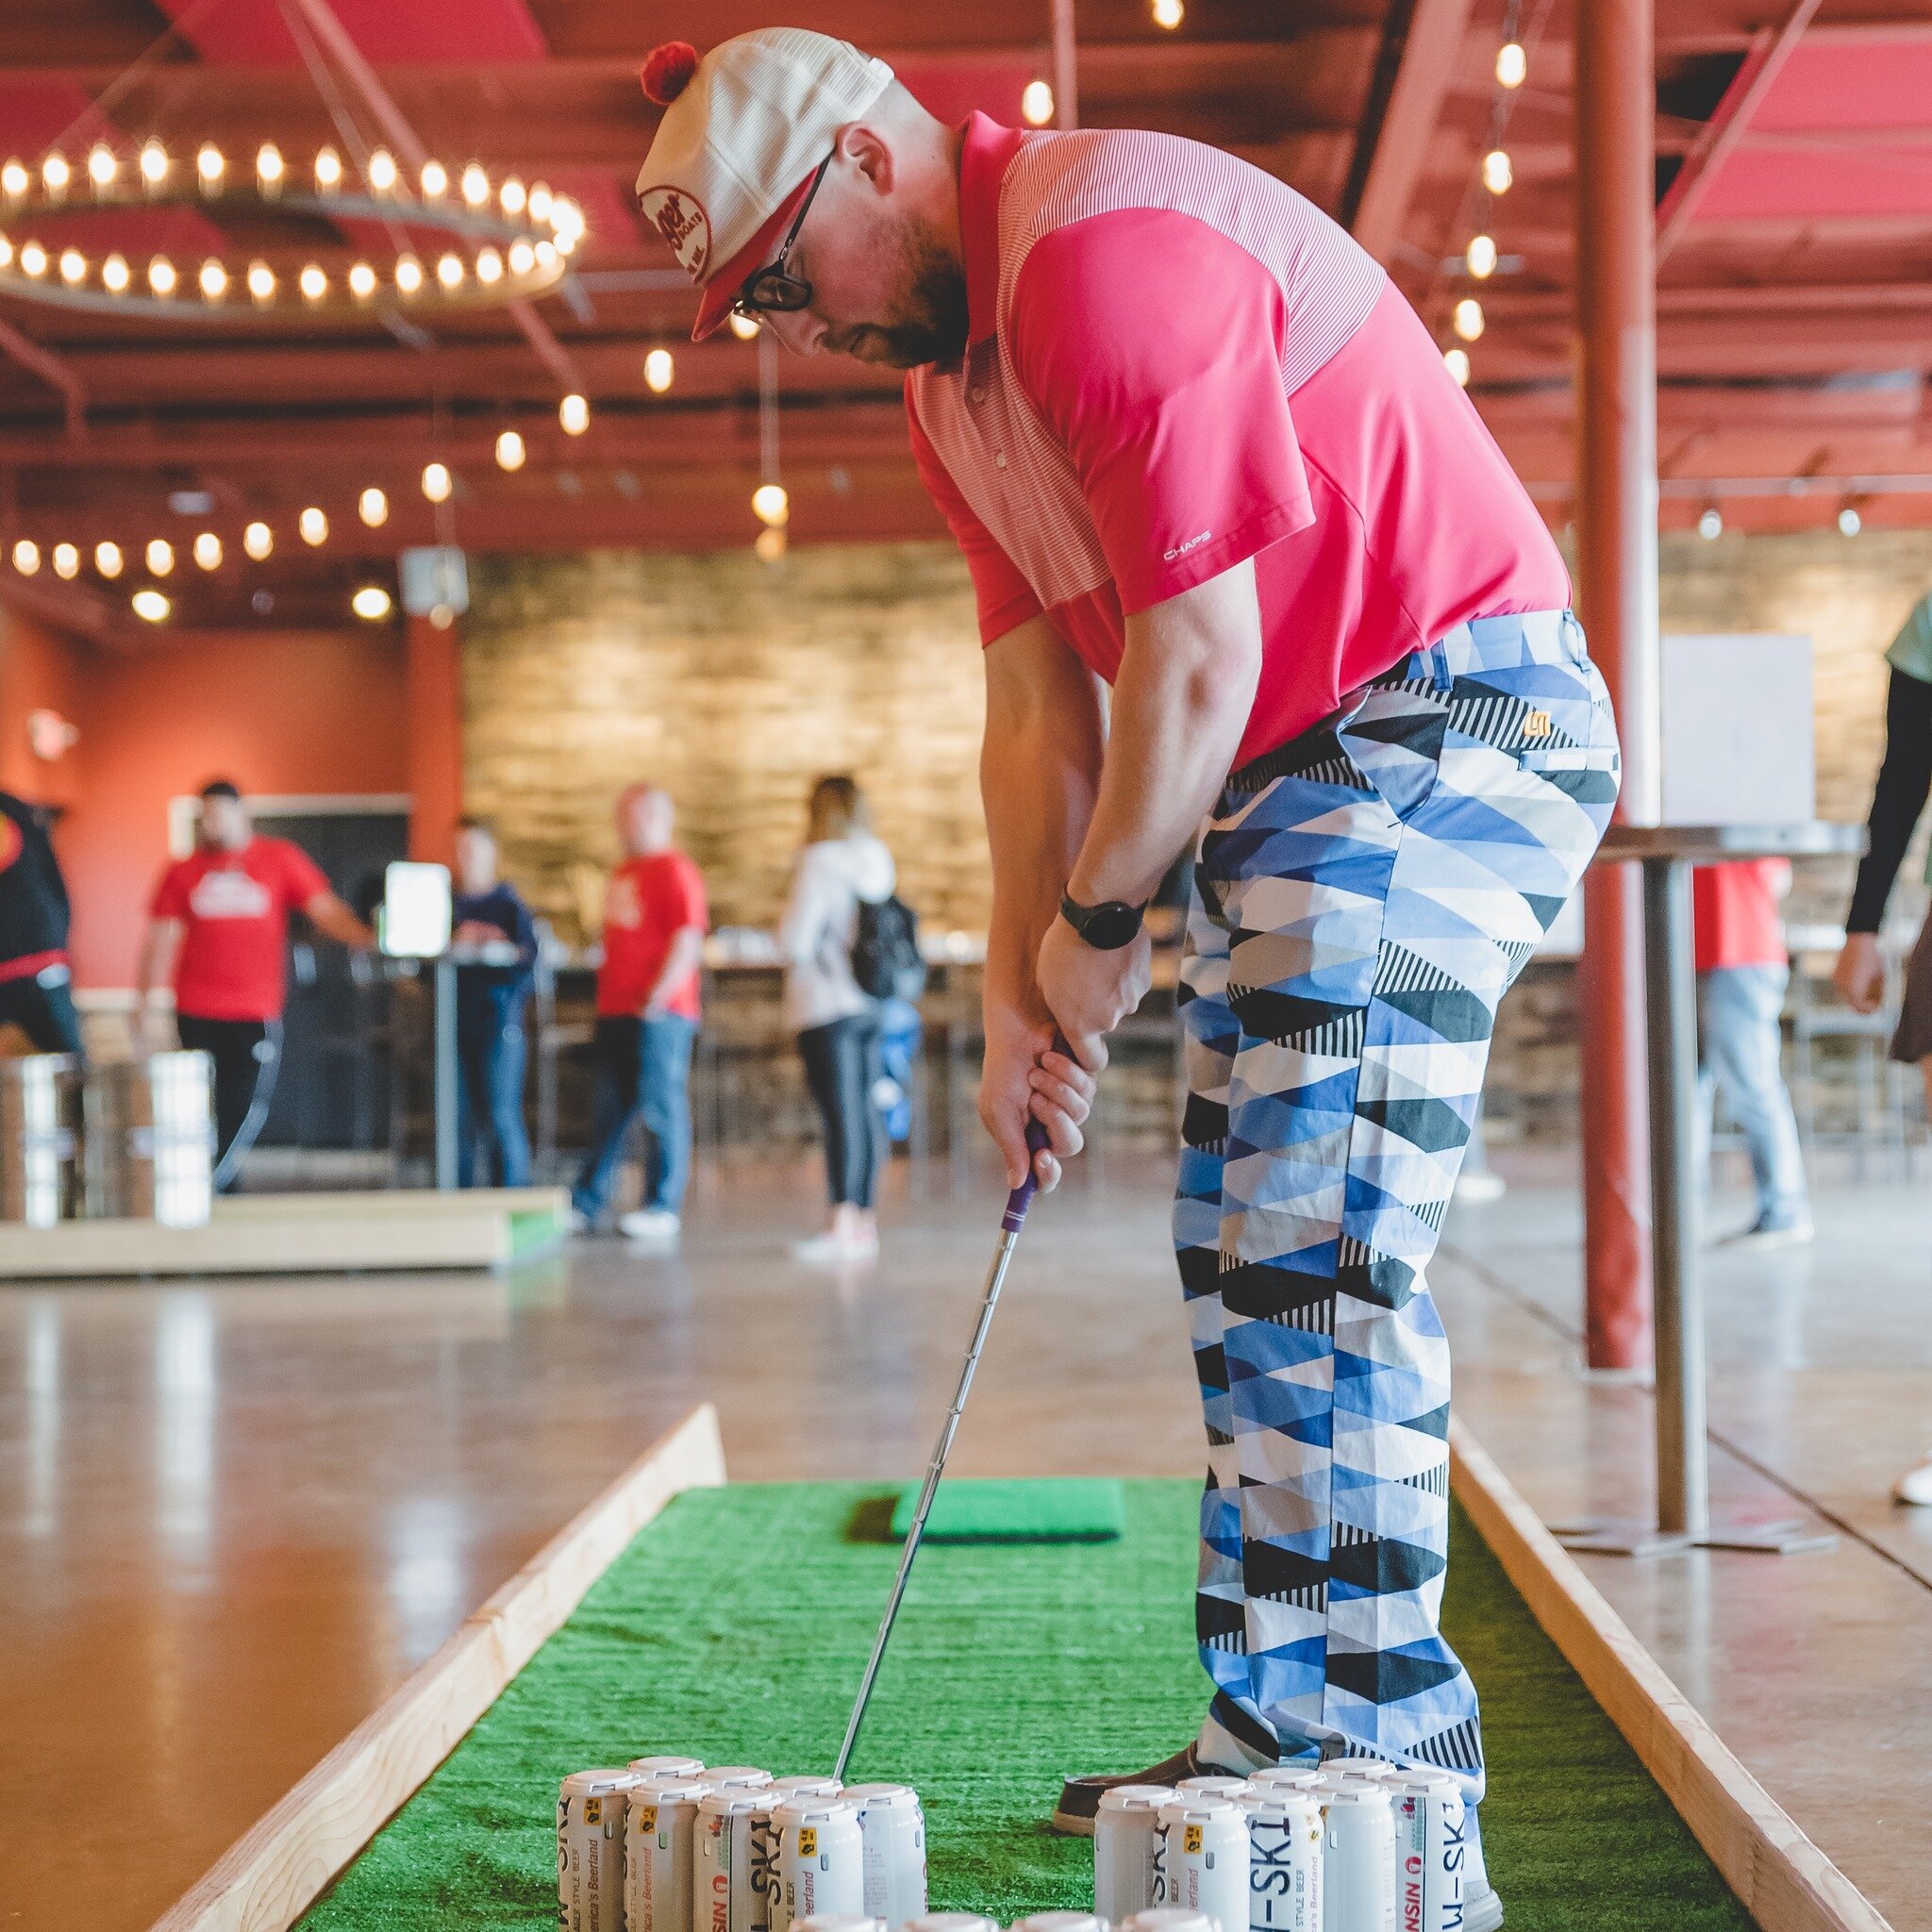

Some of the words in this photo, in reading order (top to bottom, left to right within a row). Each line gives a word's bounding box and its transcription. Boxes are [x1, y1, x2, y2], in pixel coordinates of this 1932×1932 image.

[1163, 529, 1211, 561] CHAPS
[588, 1839, 599, 1890] Beerland
[641, 1847, 652, 1900] Beerland
[1250, 1817, 1291, 1932] -SKI
[1296, 1869, 1305, 1892] BEER
[786, 1881, 795, 1905] BEER
[804, 1870, 814, 1916] eerland
[1171, 1877, 1179, 1903] BEER
[1296, 1897, 1305, 1926] STYLE
